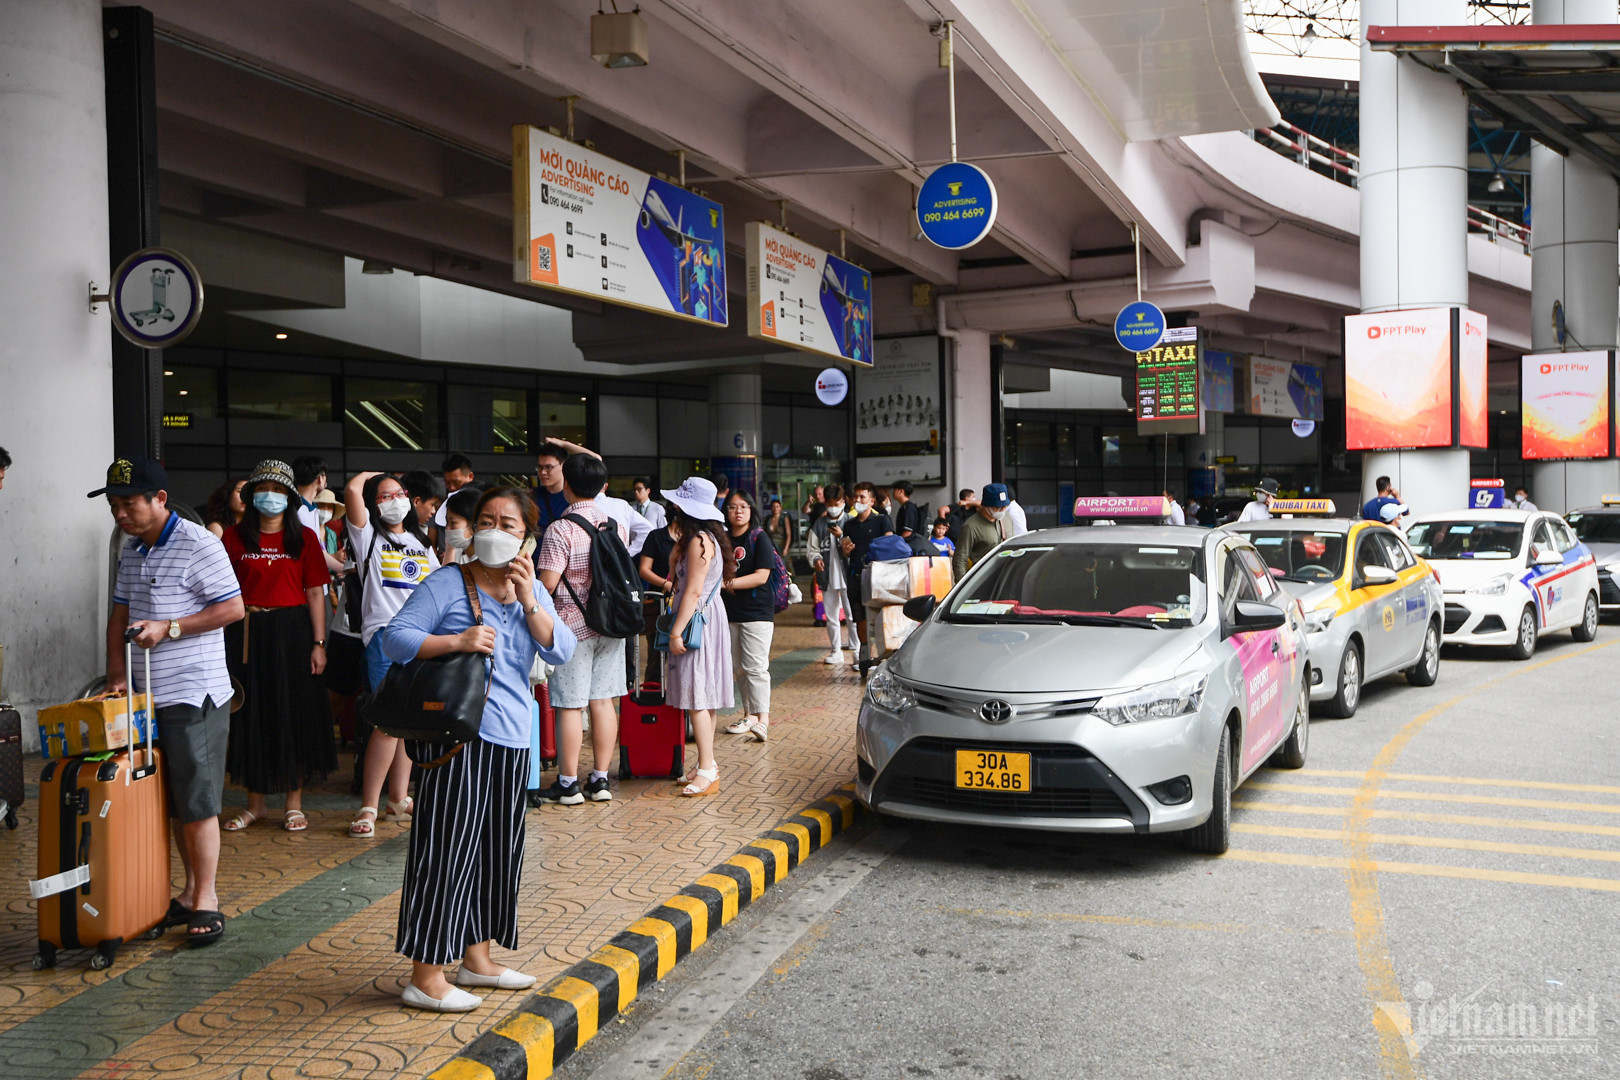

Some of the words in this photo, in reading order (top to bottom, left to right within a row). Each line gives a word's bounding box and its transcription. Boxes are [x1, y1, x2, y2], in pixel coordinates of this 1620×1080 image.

[540, 147, 562, 171] MỜI
[566, 159, 605, 187] QUẢNG
[607, 174, 629, 196] CÁO
[541, 168, 594, 197] ADVERTISING
[550, 196, 559, 207] 090
[571, 203, 583, 214] 6699
[933, 197, 977, 208] ADVERTISING
[924, 212, 941, 223] 090
[943, 210, 959, 220] 464
[962, 207, 985, 219] 6699
[765, 238, 778, 253] MỜI
[780, 244, 802, 264] QUẢNG
[803, 254, 816, 269] CÁO
[766, 253, 796, 271] ADVERTISING
[1383, 326, 1402, 335] FPT
[1405, 325, 1426, 336] Play
[1151, 345, 1196, 362] TAXI
[1553, 364, 1569, 372] FPT
[1571, 363, 1589, 372] Play
[734, 433, 744, 448] 6
[1077, 498, 1135, 507] AIRPORT
[1135, 498, 1163, 506] TAXI
[1272, 501, 1303, 509] NOIBAI
[1306, 501, 1326, 509] TAXI
[1476, 490, 1494, 508] G7
[1090, 506, 1148, 514] www.airporttaxi.vn
[1250, 666, 1269, 697] AIRPORT
[977, 753, 1008, 770] 30A
[964, 771, 1022, 789] 334.86
